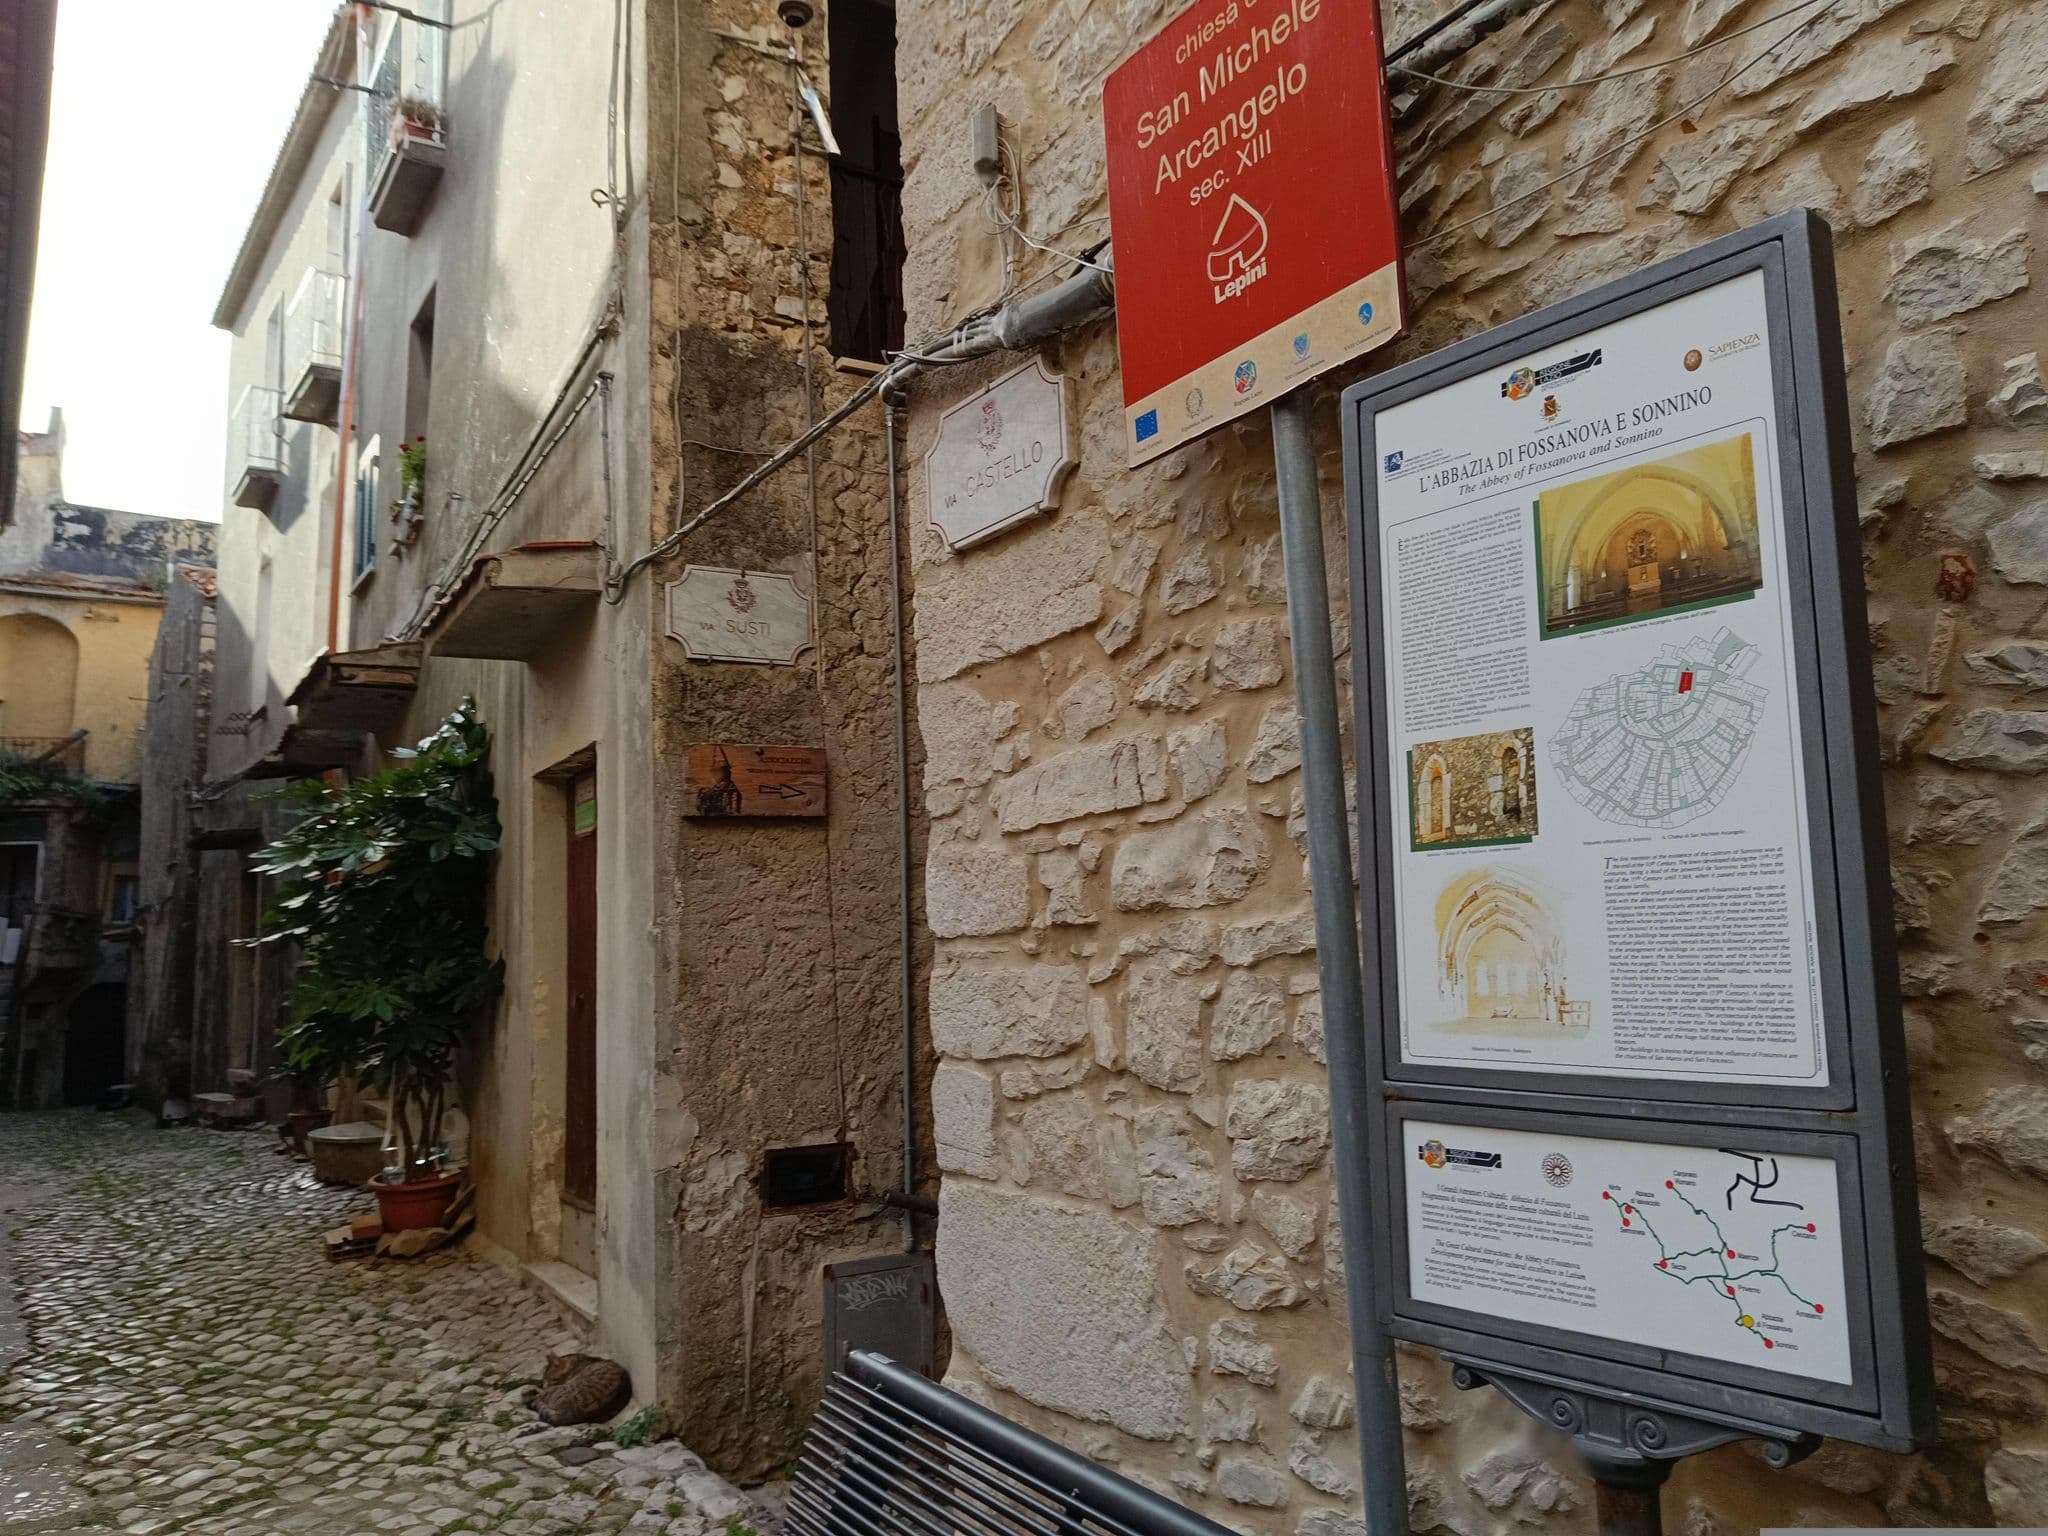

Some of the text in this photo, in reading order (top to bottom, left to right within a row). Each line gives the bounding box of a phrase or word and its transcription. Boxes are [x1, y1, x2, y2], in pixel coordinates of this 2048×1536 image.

[1176, 1, 1239, 64] chiesa
[1137, 0, 1320, 149] San Michele
[1154, 62, 1307, 195] Arcangelo
[1190, 128, 1272, 206] sec. XIII
[1214, 256, 1268, 305] Lepini
[1458, 425, 1664, 496] The Abbey of Fossanova and Sonnino
[1498, 448, 1514, 469] DI
[1518, 418, 1613, 462] FOSSANOVA
[1617, 412, 1627, 432] E
[1632, 385, 1713, 426] SONNINO
[967, 440, 1043, 498] CASTELLO
[726, 619, 772, 636] SUSTI
